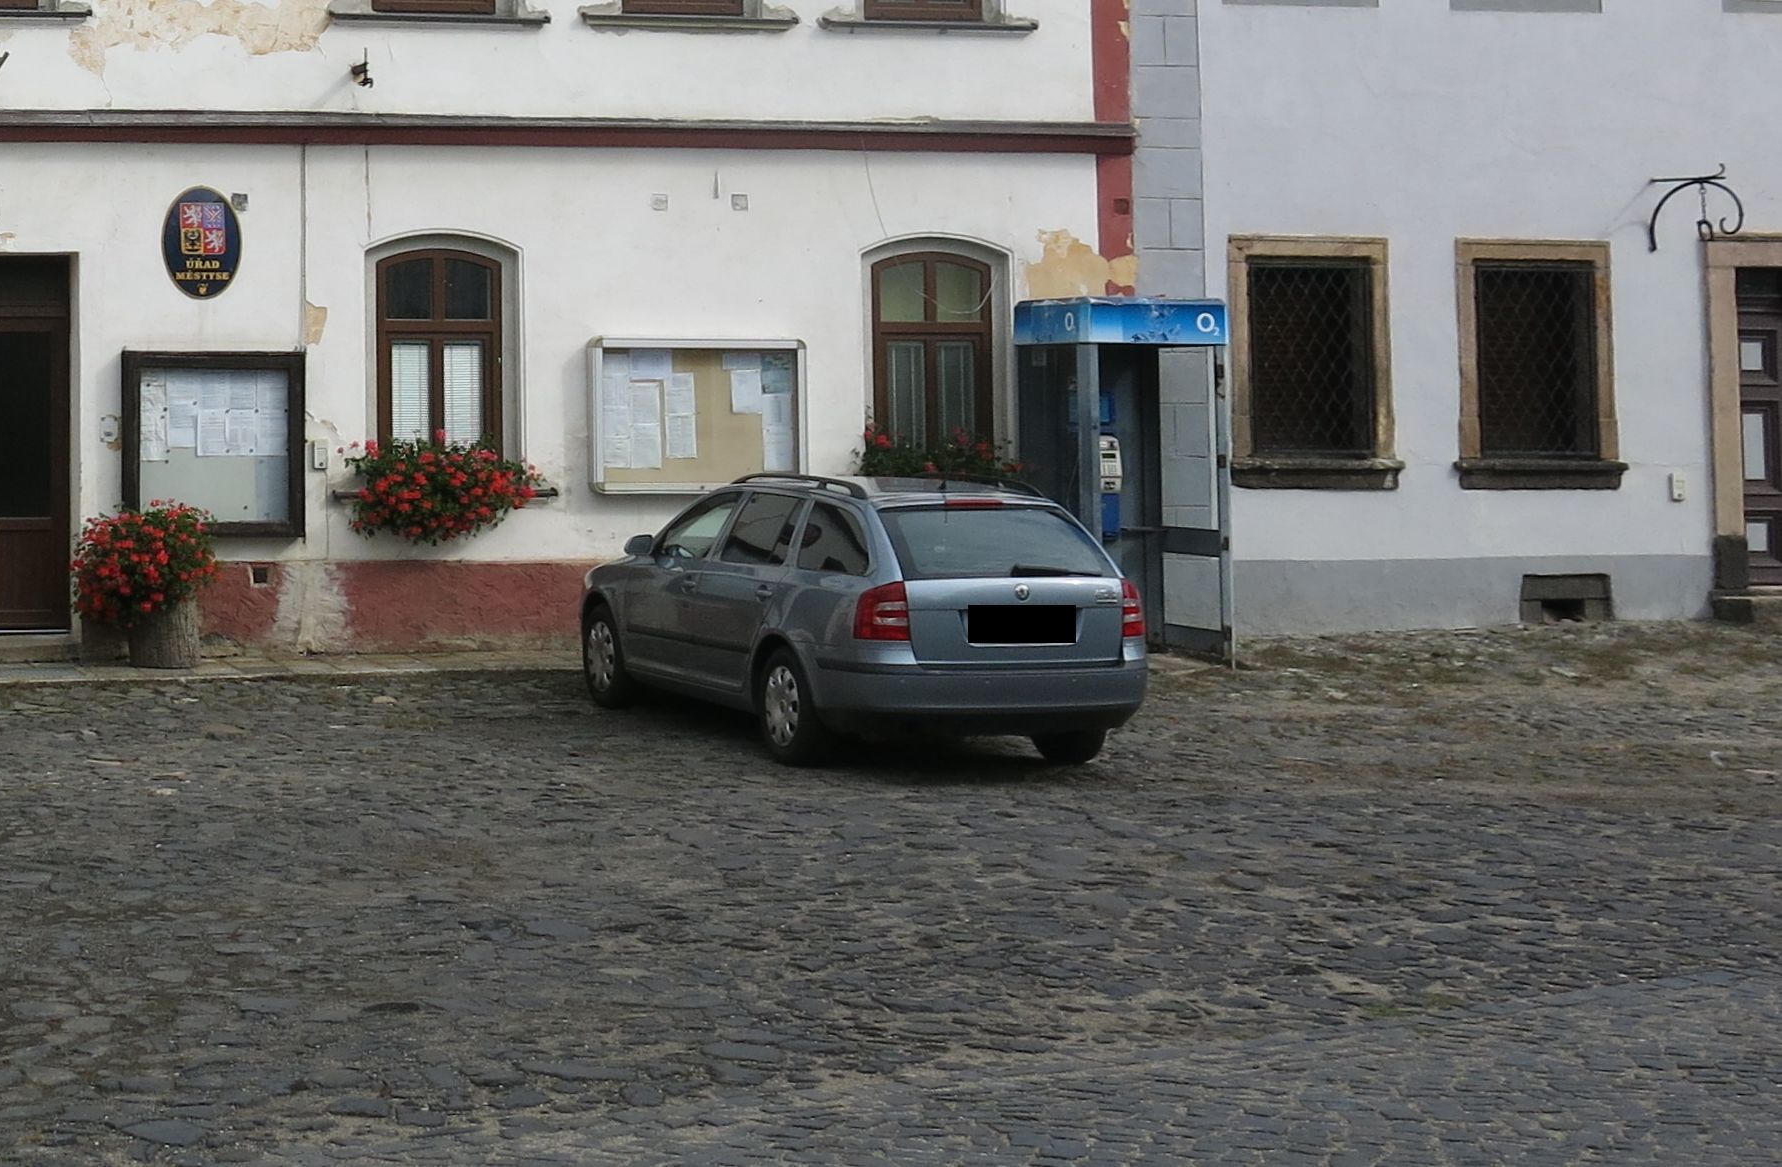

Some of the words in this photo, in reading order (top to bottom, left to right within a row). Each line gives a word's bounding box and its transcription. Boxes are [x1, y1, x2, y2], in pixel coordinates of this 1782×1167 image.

[185, 257, 220, 269] ÚŘAD
[176, 269, 230, 280] MĚSTYSE
[1196, 312, 1220, 336] O2
